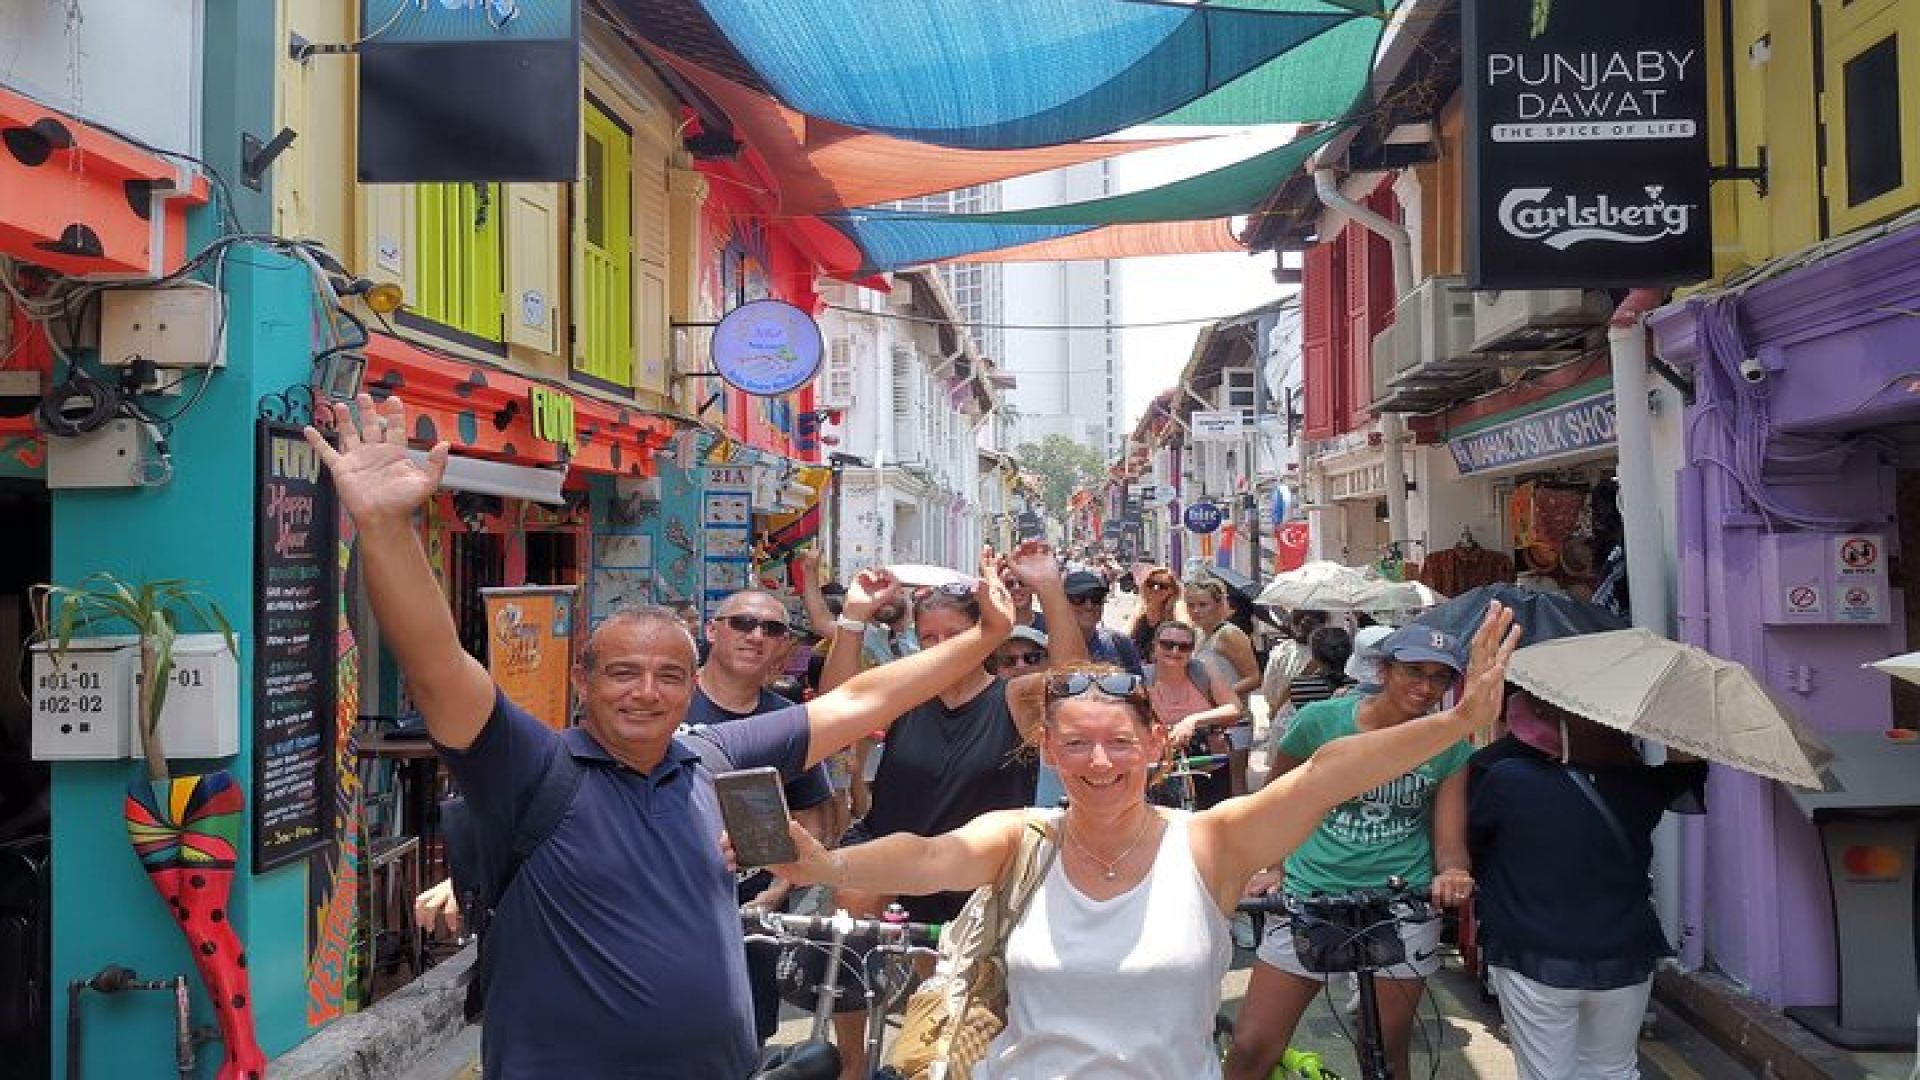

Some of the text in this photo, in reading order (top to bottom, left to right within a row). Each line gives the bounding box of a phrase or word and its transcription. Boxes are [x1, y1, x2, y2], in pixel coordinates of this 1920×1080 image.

[1488, 50, 1694, 90] PUNJABY
[1519, 90, 1667, 119] DAWAT
[1500, 123, 1689, 138] THE SPICE OF LIFE
[1499, 187, 1689, 241] Carlsberg
[712, 470, 746, 484] 21A
[266, 484, 313, 526] Happy
[39, 672, 101, 690] #01-01
[39, 694, 102, 713] #02-02
